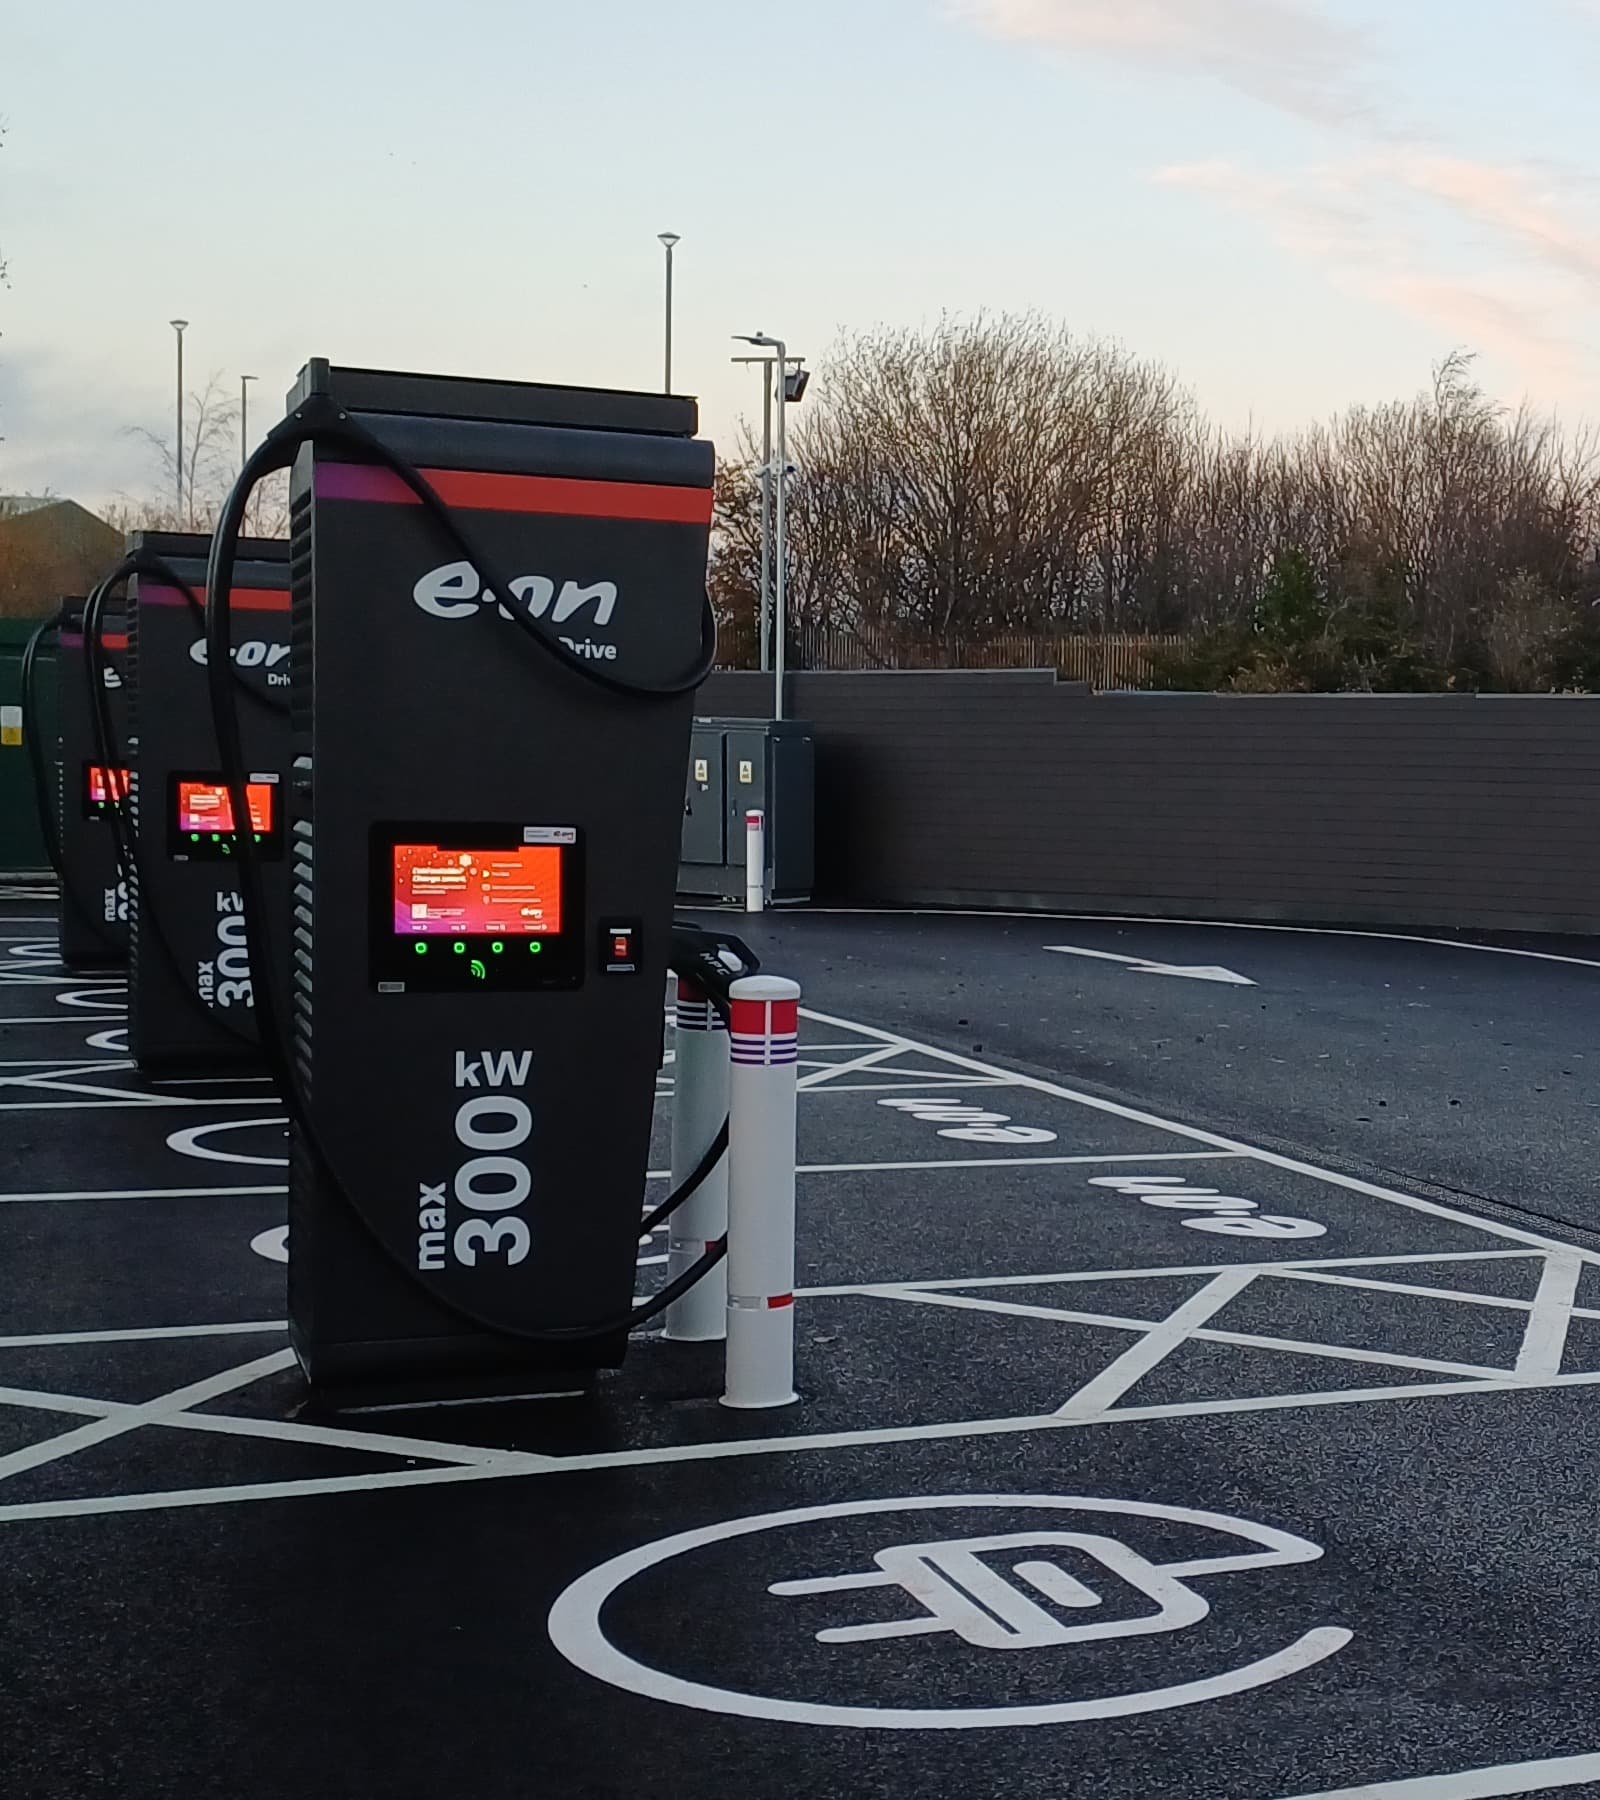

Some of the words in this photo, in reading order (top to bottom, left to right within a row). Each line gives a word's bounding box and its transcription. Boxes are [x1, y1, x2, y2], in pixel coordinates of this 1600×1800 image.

[267, 673, 291, 687] Dri
[455, 1050, 533, 1088] kW
[453, 1095, 533, 1267] 300
[418, 1182, 447, 1270] max
